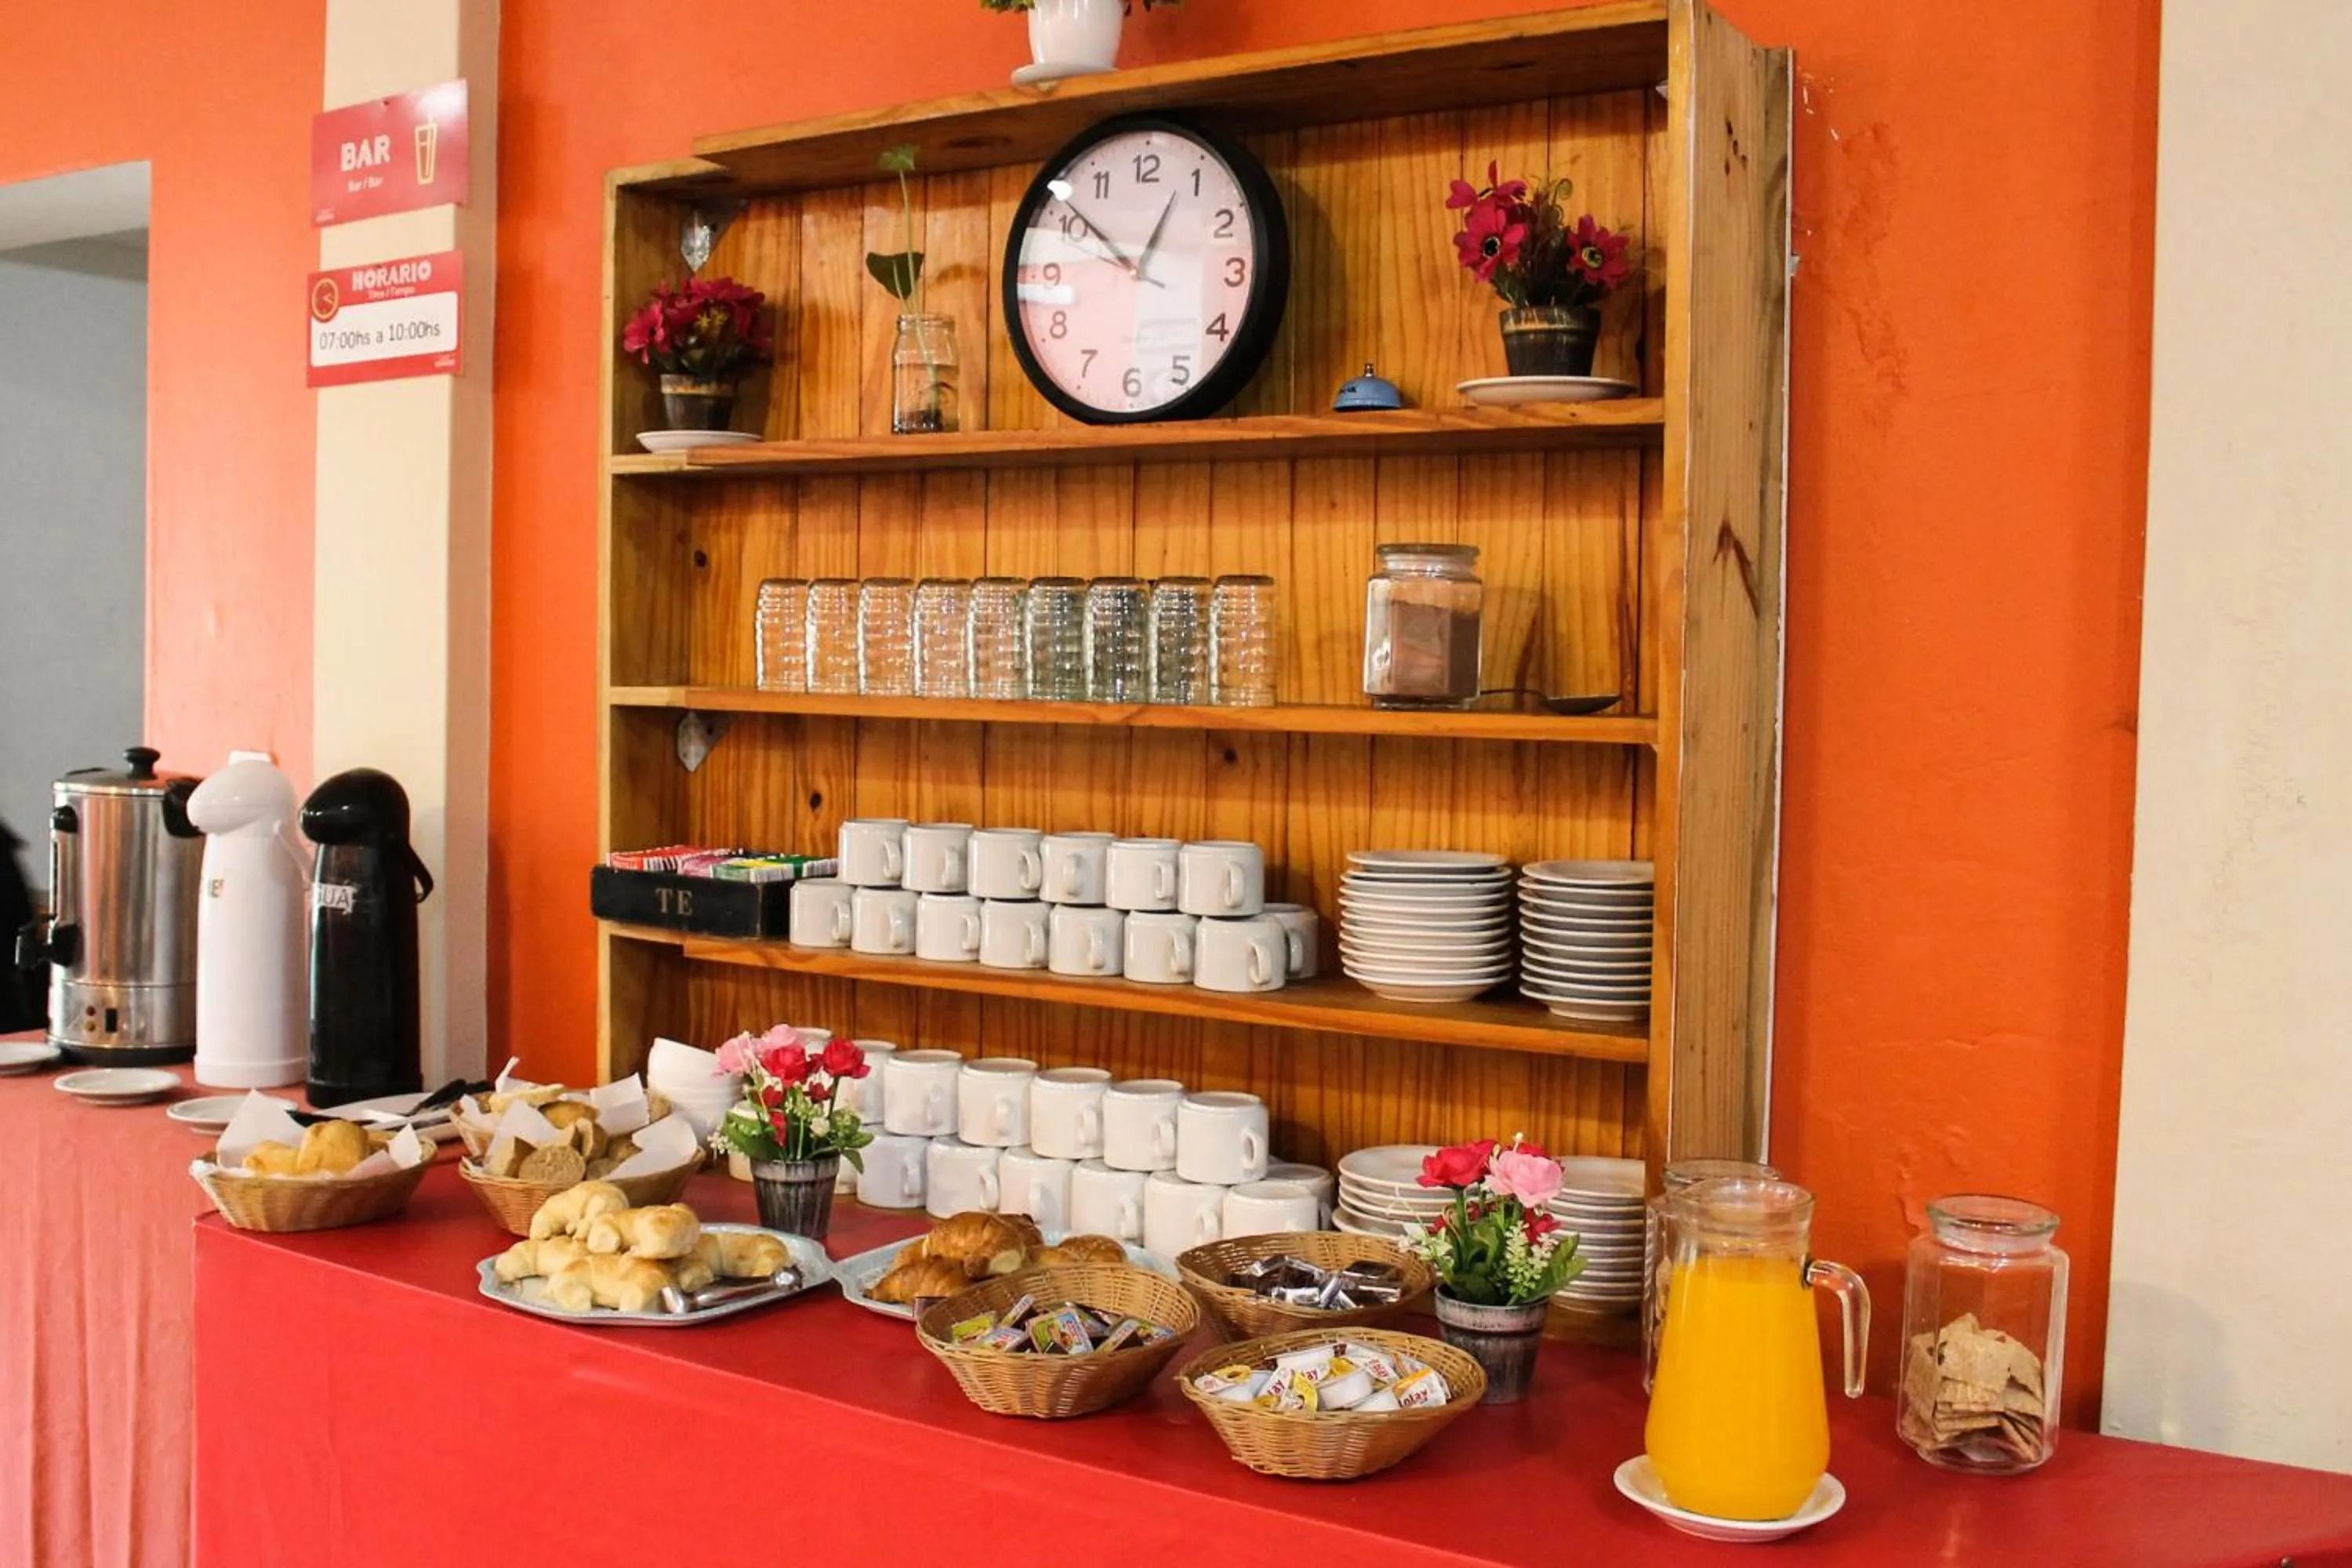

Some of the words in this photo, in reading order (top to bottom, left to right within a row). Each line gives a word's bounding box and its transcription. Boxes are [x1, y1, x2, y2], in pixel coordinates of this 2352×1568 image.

[341, 135, 390, 172] BAR
[1134, 154, 1160, 183] 12
[1191, 168, 1201, 197] 1
[1094, 171, 1110, 199] 11
[1058, 215, 1088, 243] 10
[1213, 209, 1233, 238] 2
[352, 260, 431, 291] HORARIO
[1044, 263, 1061, 289] 9
[1224, 257, 1245, 287] 3
[320, 331, 370, 350] 07:00hs
[376, 329, 383, 343] a
[389, 321, 441, 342] 10:00hs
[1050, 310, 1067, 339] 8
[1206, 313, 1229, 342] 4
[1080, 350, 1098, 378] 7
[1171, 355, 1191, 386] 5
[1123, 368, 1142, 397] 6
[655, 887, 692, 916] TE
